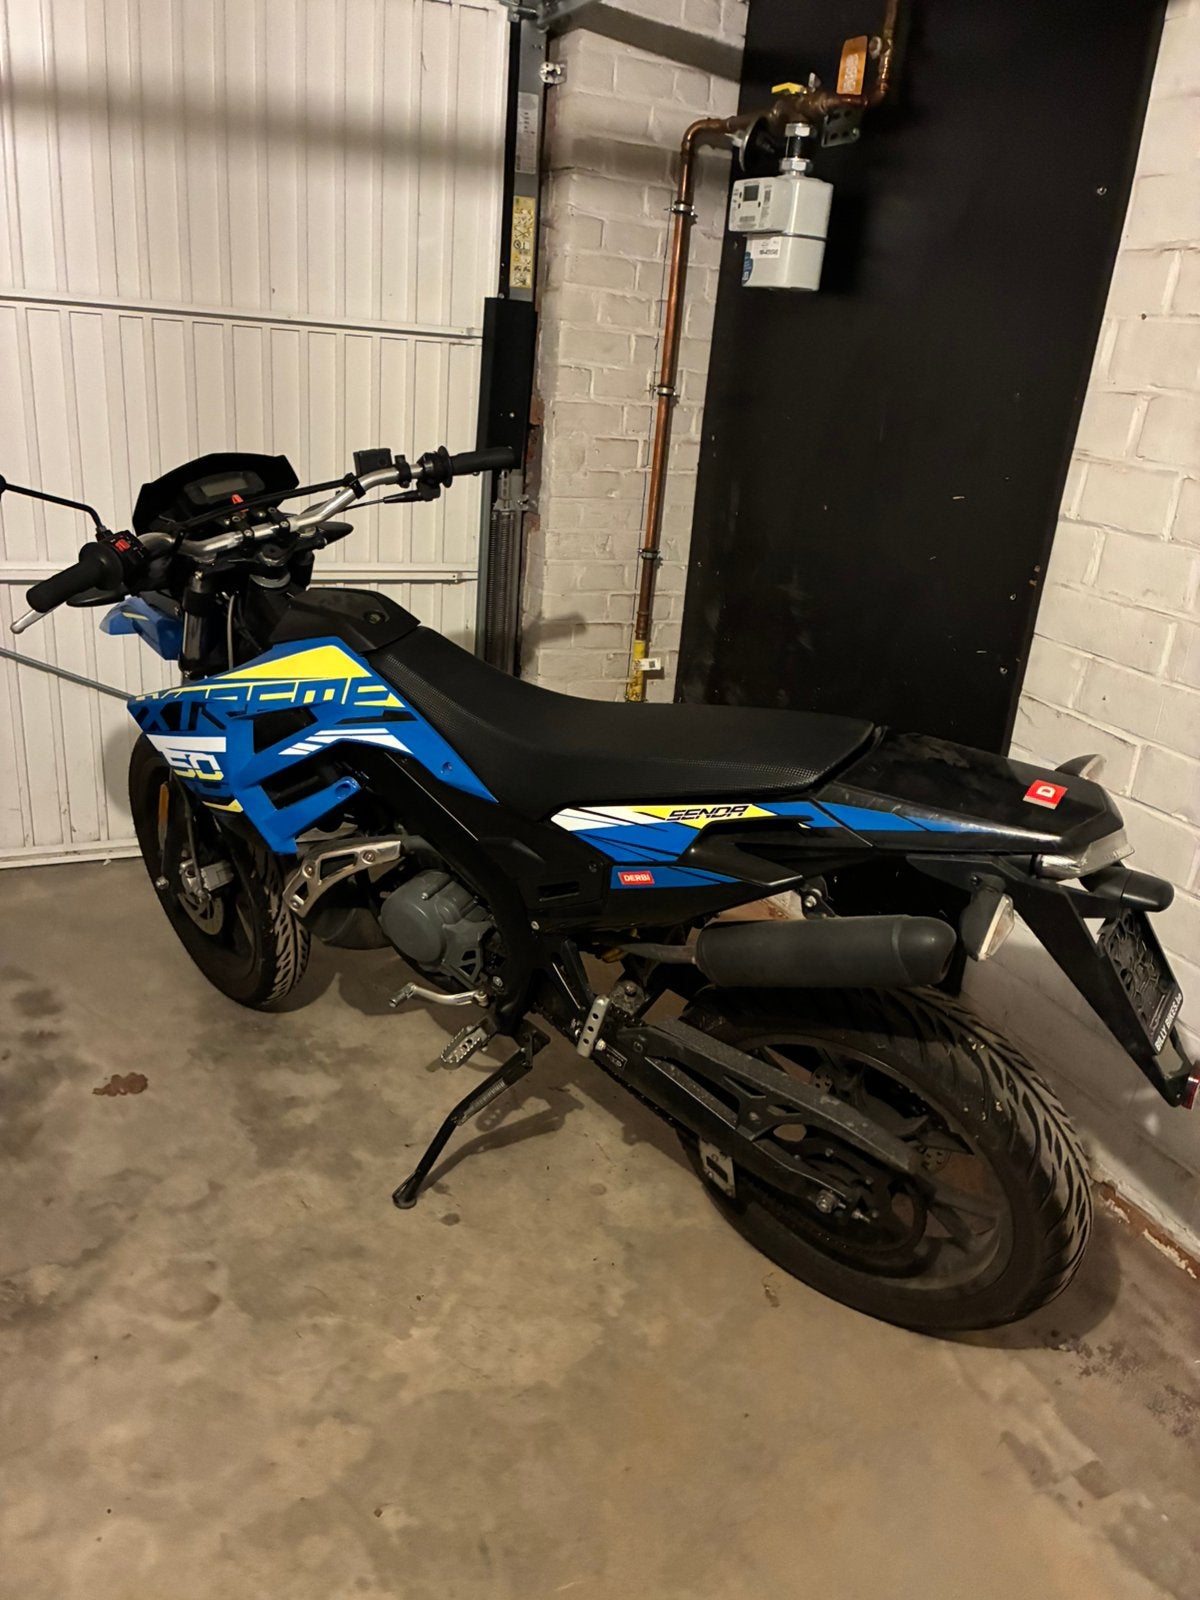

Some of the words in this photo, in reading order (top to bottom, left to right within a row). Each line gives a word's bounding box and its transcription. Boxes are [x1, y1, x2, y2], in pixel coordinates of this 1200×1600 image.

[163, 751, 224, 781] 50
[1035, 785, 1056, 799] D
[666, 805, 749, 821] SENDA
[1154, 1025, 1168, 1052] BILLY
